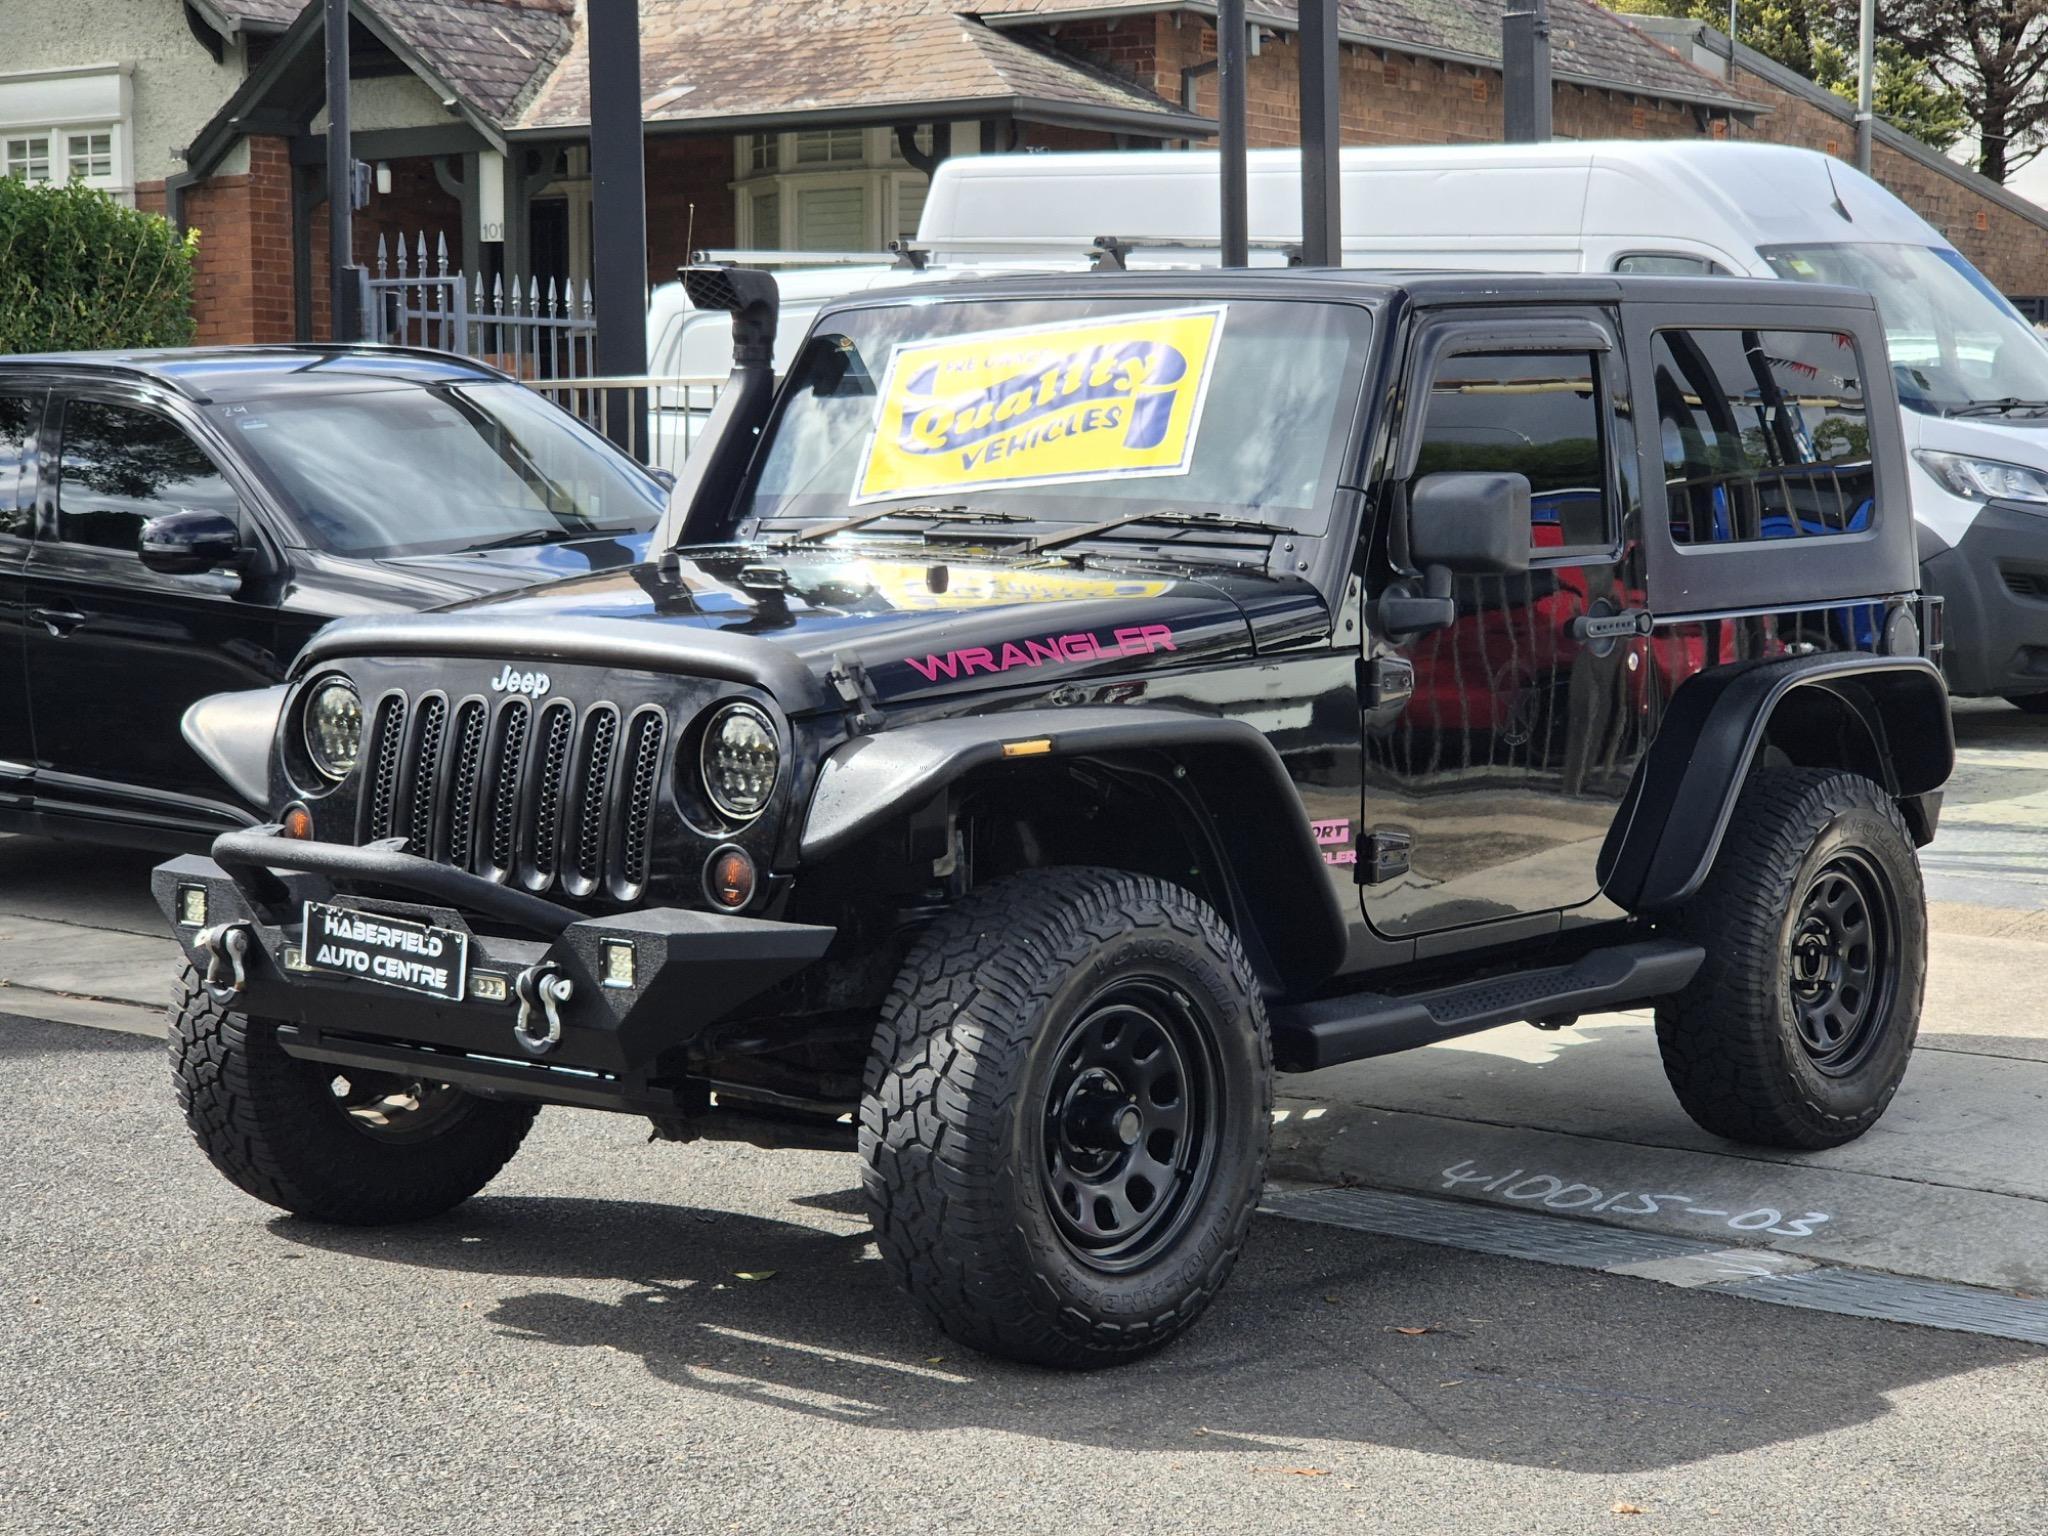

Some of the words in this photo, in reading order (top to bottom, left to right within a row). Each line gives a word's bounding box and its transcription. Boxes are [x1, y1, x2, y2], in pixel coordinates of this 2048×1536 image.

[482, 222, 504, 240] 101
[908, 345, 1165, 450] Quality
[962, 406, 1122, 470] VEHICLES
[904, 624, 1177, 681] WRANGLER
[491, 664, 551, 699] Jeep
[324, 914, 443, 958] HABERFIELD
[316, 944, 370, 972] AUTO
[372, 955, 449, 990] CENTRE
